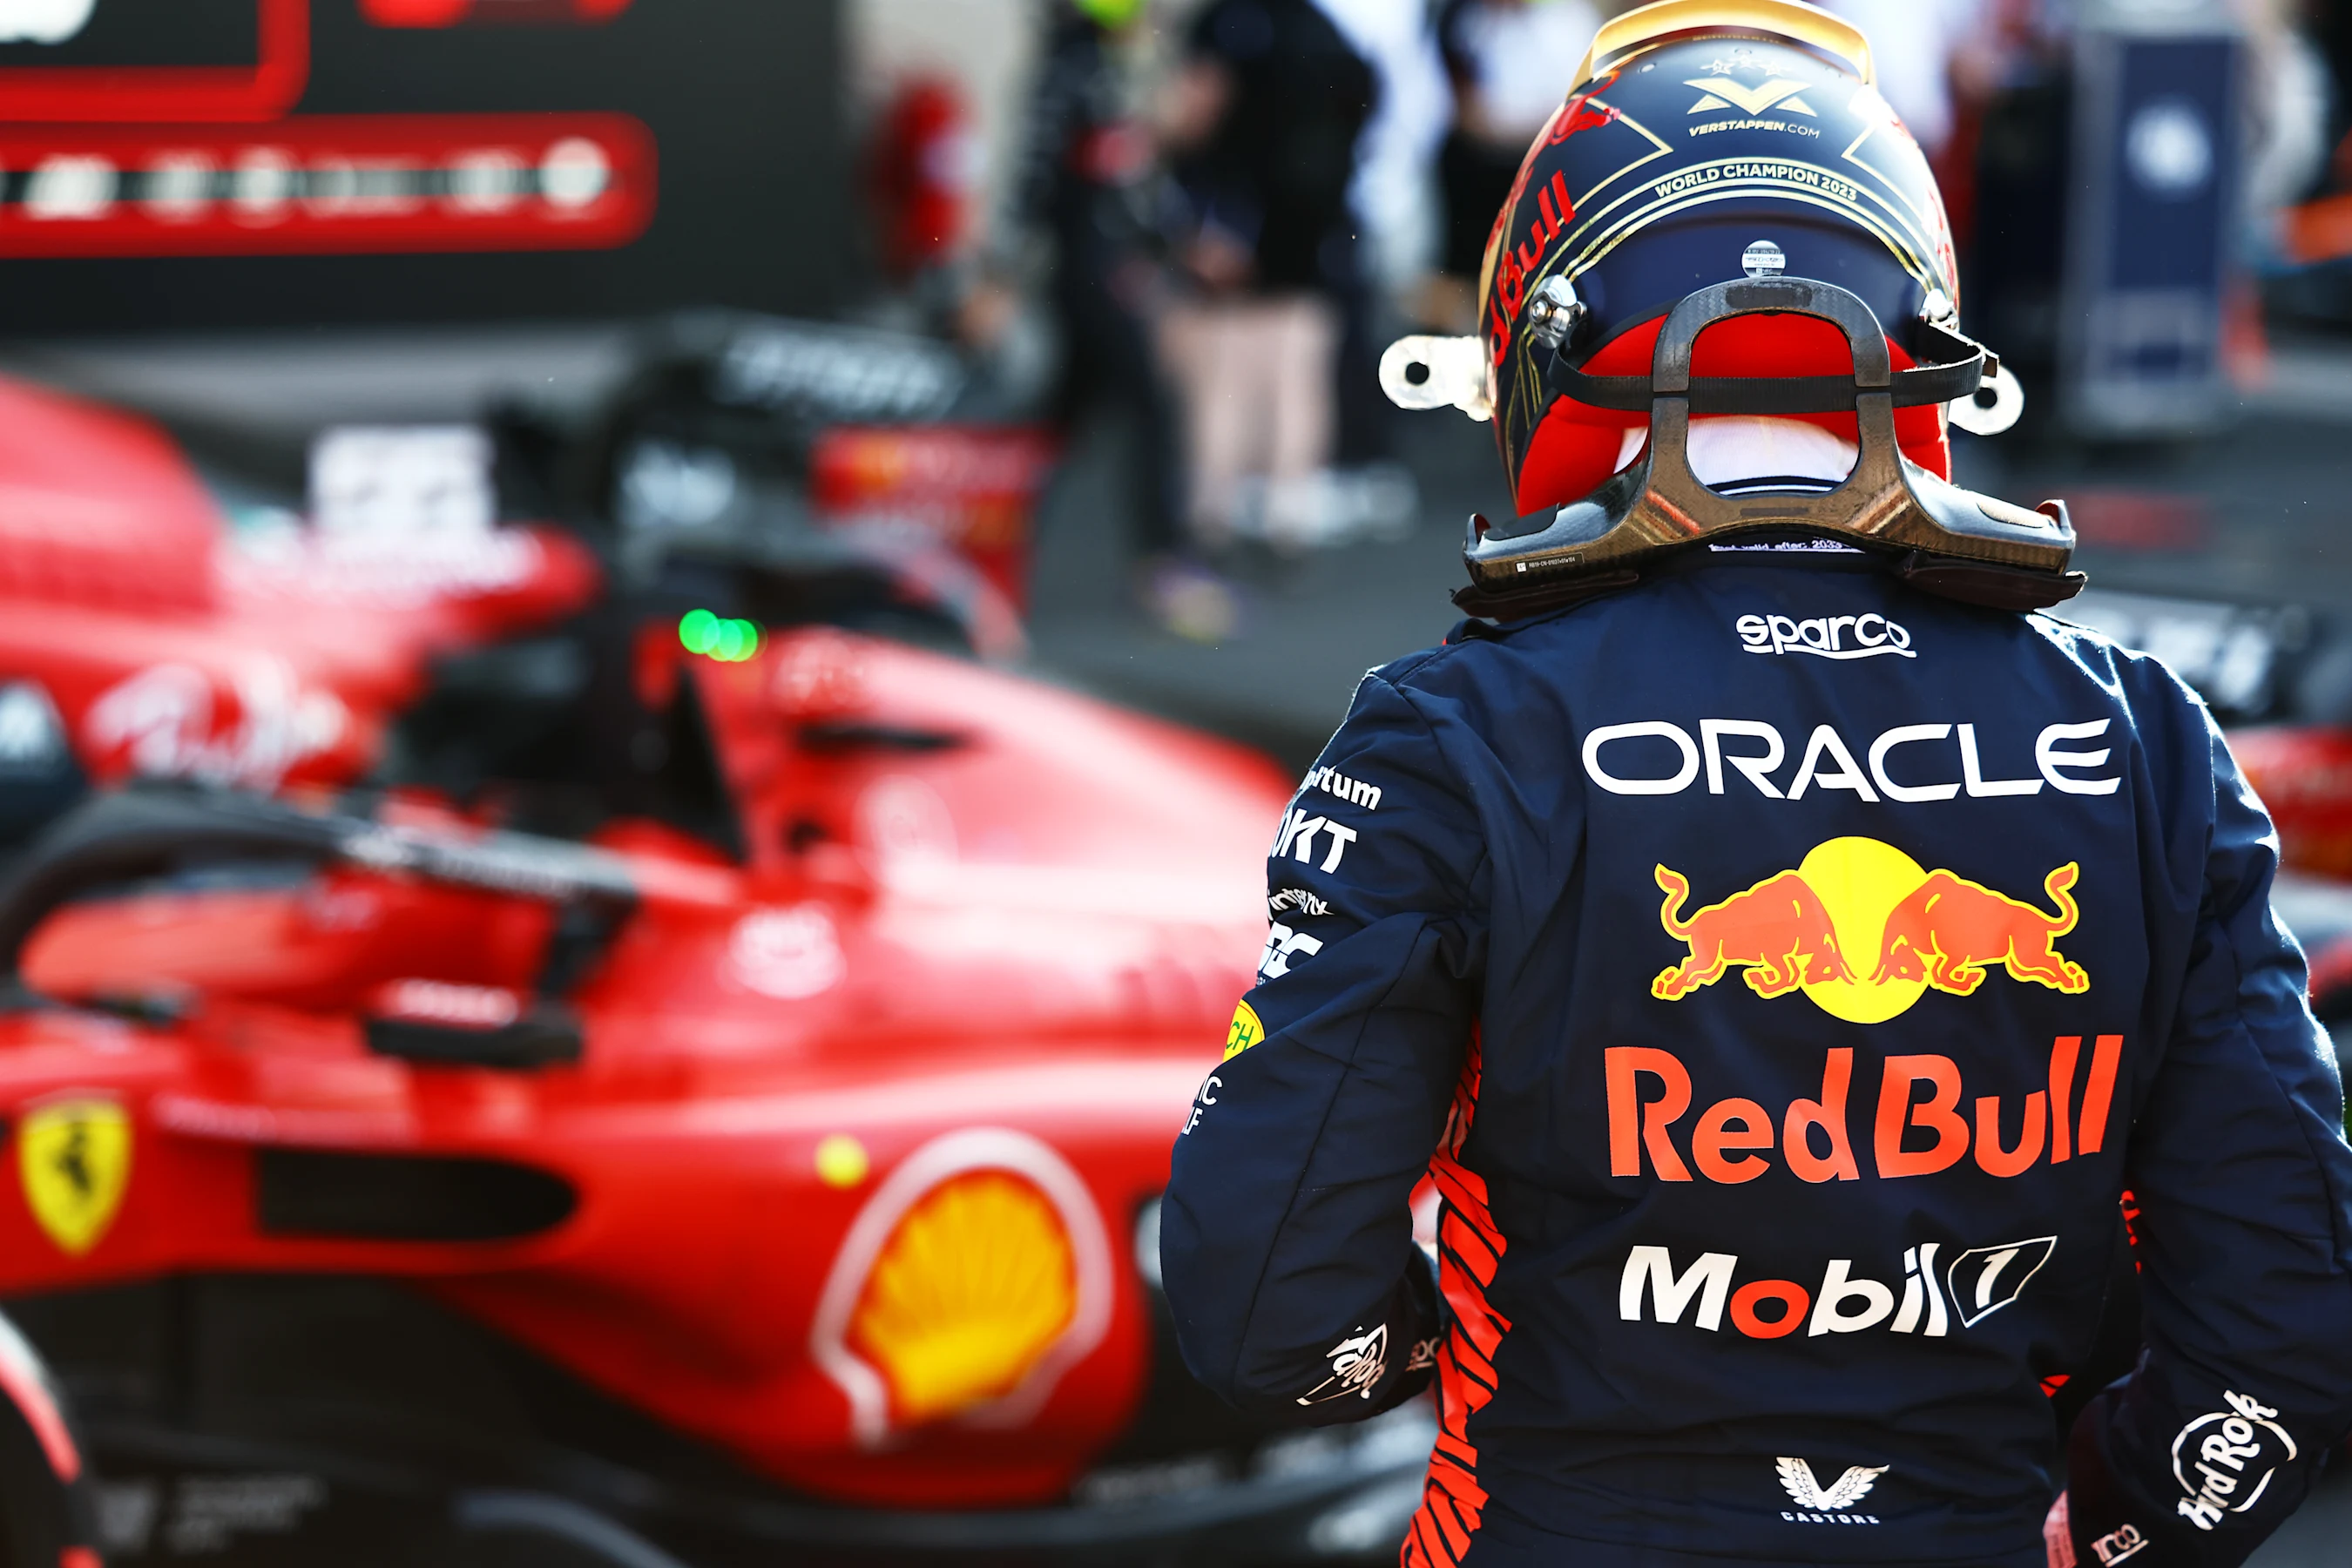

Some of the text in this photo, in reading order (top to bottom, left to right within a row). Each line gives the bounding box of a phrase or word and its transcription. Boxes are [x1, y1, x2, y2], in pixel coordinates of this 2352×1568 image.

[1688, 119, 1820, 139] VERSTAPPEN.COM
[1654, 163, 1857, 201] WORLD CHAMPION 2023
[1496, 169, 1576, 321] Bull
[1735, 612, 1910, 655] sparco
[1582, 718, 2122, 803] ORACLE
[1604, 1034, 2124, 1185] Red Bull
[1619, 1242, 2020, 1340] Mobil 1
[1780, 1511, 1881, 1524] CASTORE
